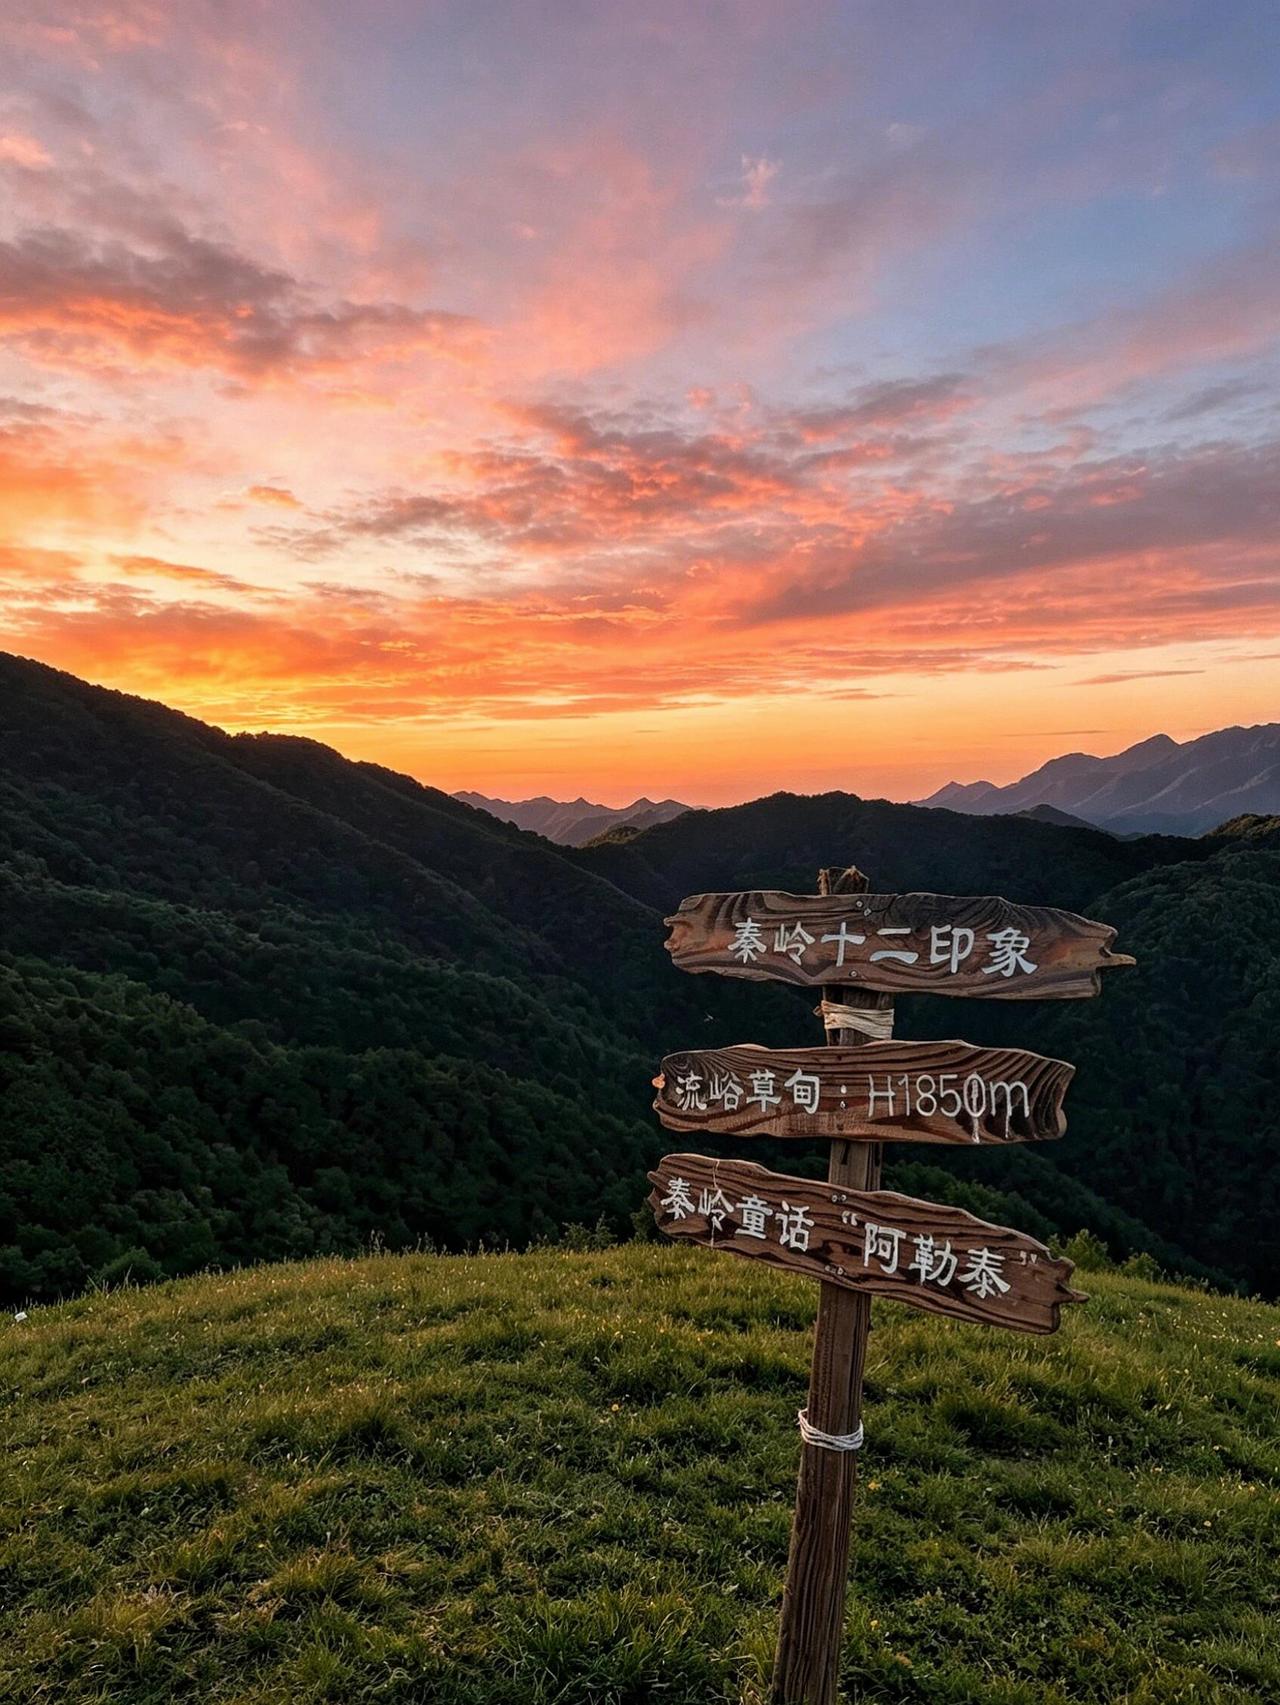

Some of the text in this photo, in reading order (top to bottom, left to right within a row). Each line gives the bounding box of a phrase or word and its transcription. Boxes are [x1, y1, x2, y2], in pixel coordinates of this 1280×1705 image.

[728, 917, 1037, 977] 秦岭十二印象
